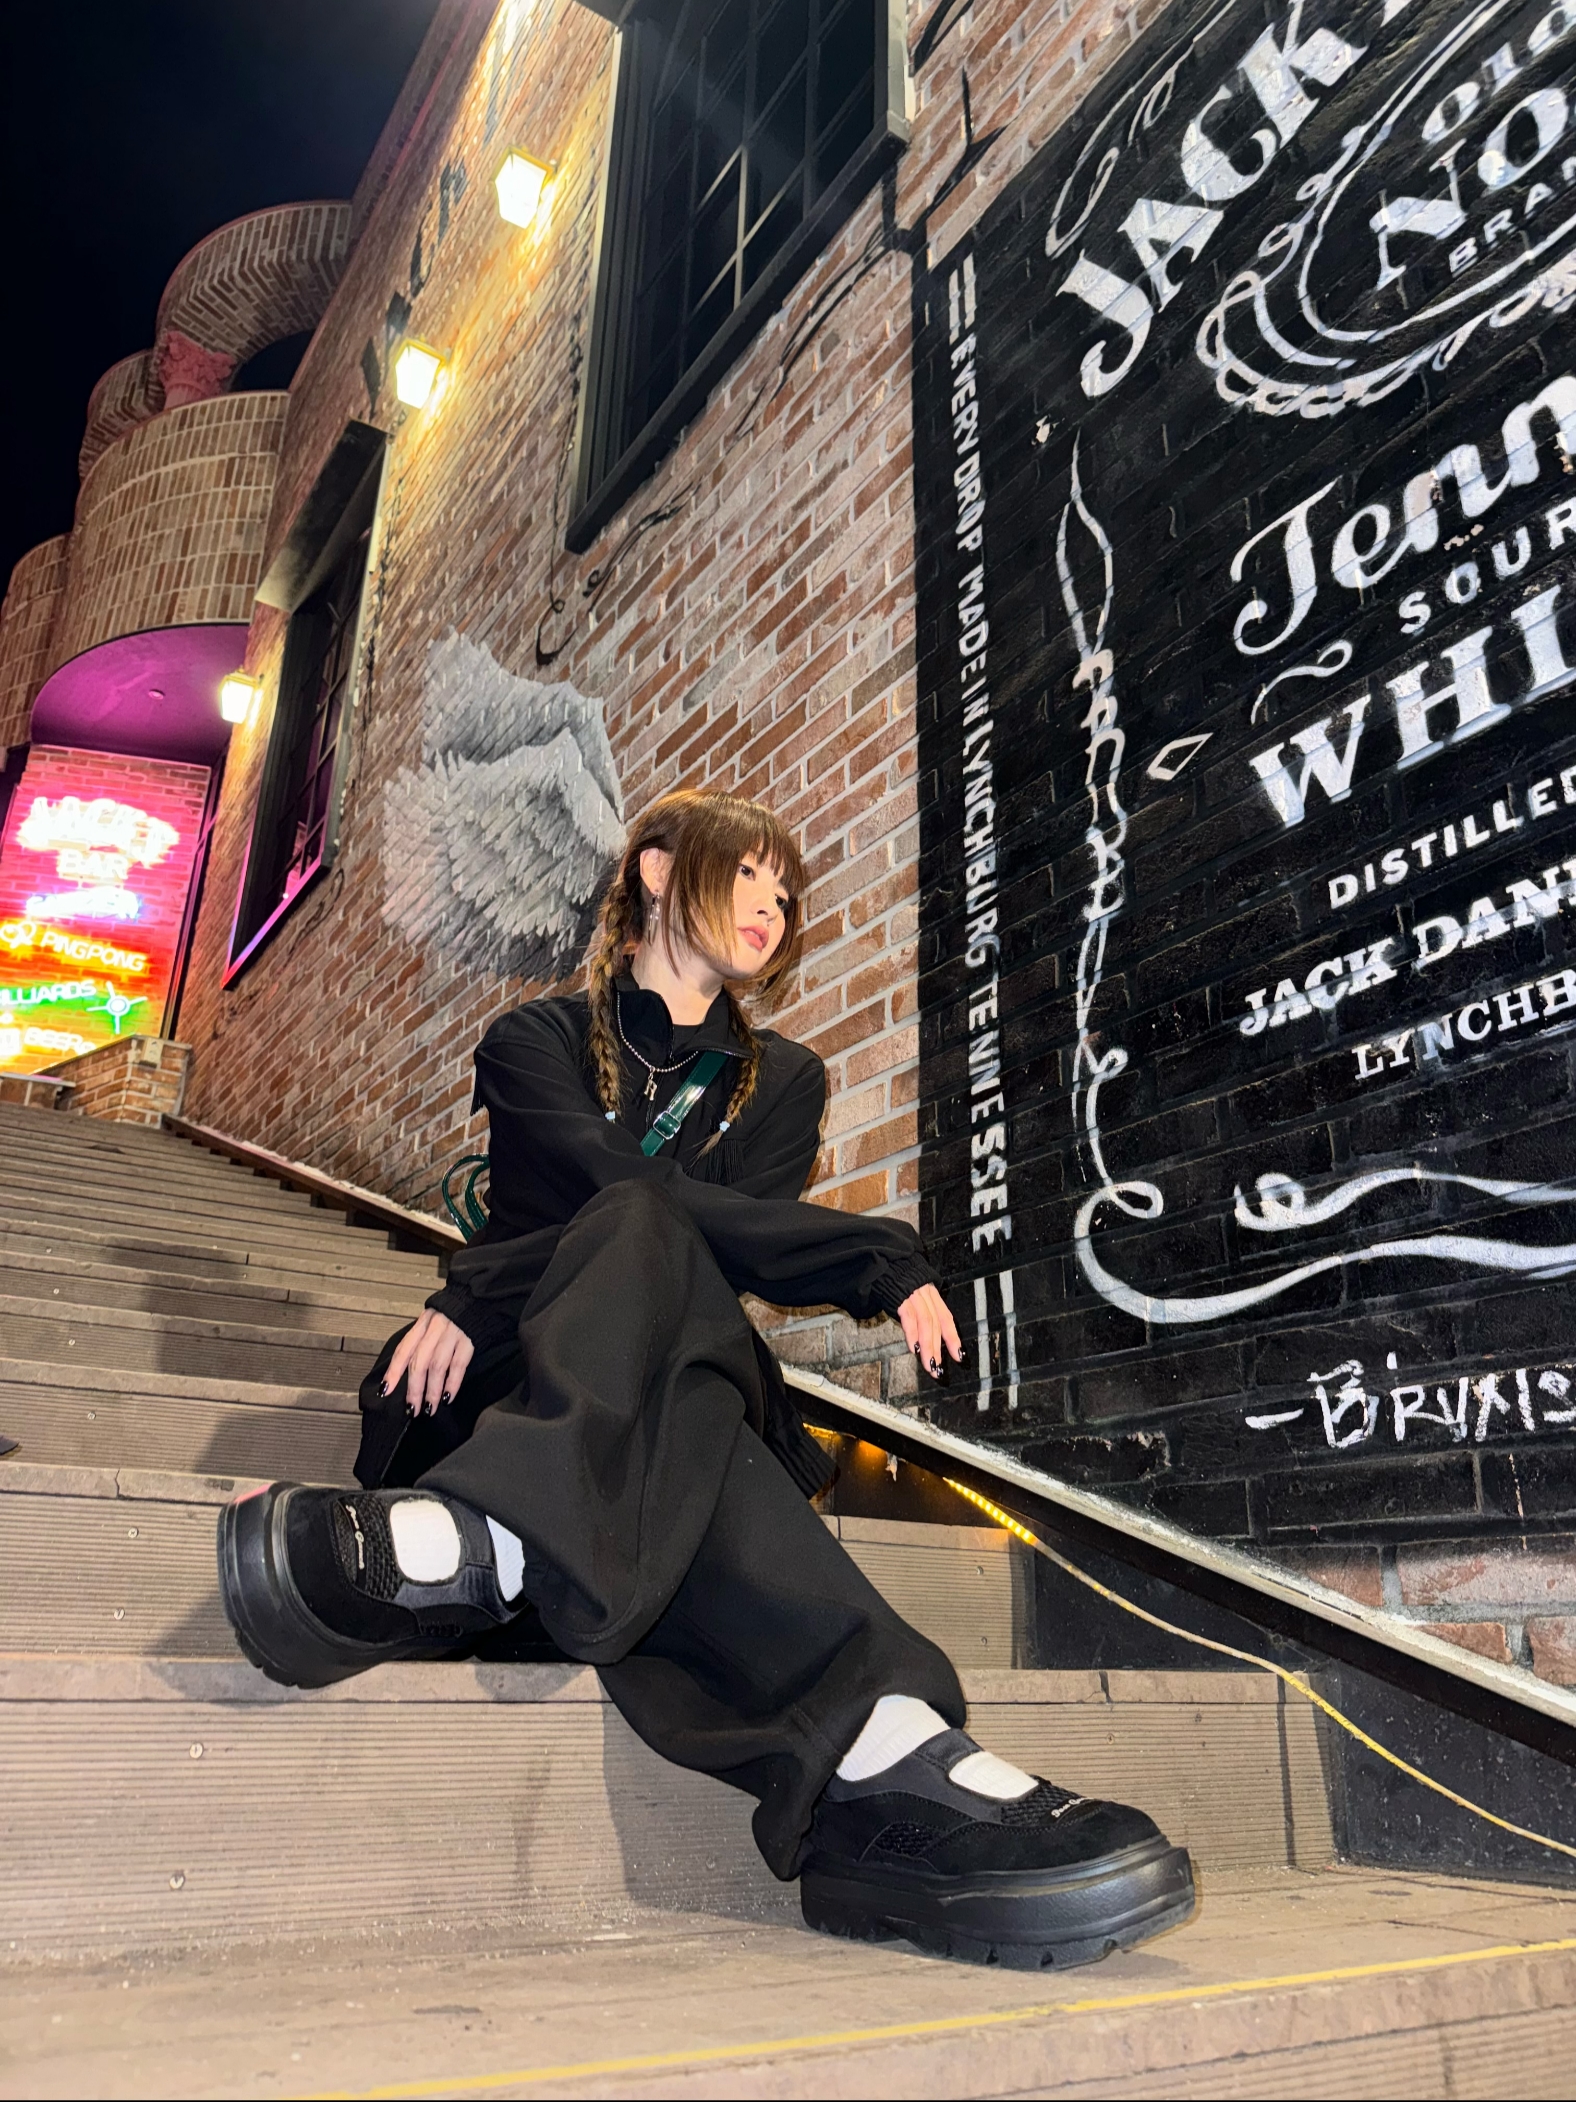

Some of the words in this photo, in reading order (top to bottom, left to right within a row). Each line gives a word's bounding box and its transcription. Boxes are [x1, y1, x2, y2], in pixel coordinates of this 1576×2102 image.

[1056, 0, 1369, 399] JACK
[954, 450, 986, 551] DROP
[957, 564, 990, 683] MADE
[1399, 496, 1576, 636] SOUR
[56, 850, 128, 879] BAR
[1239, 937, 1397, 1036] JACK
[968, 968, 1013, 1253] TENNESSEE
